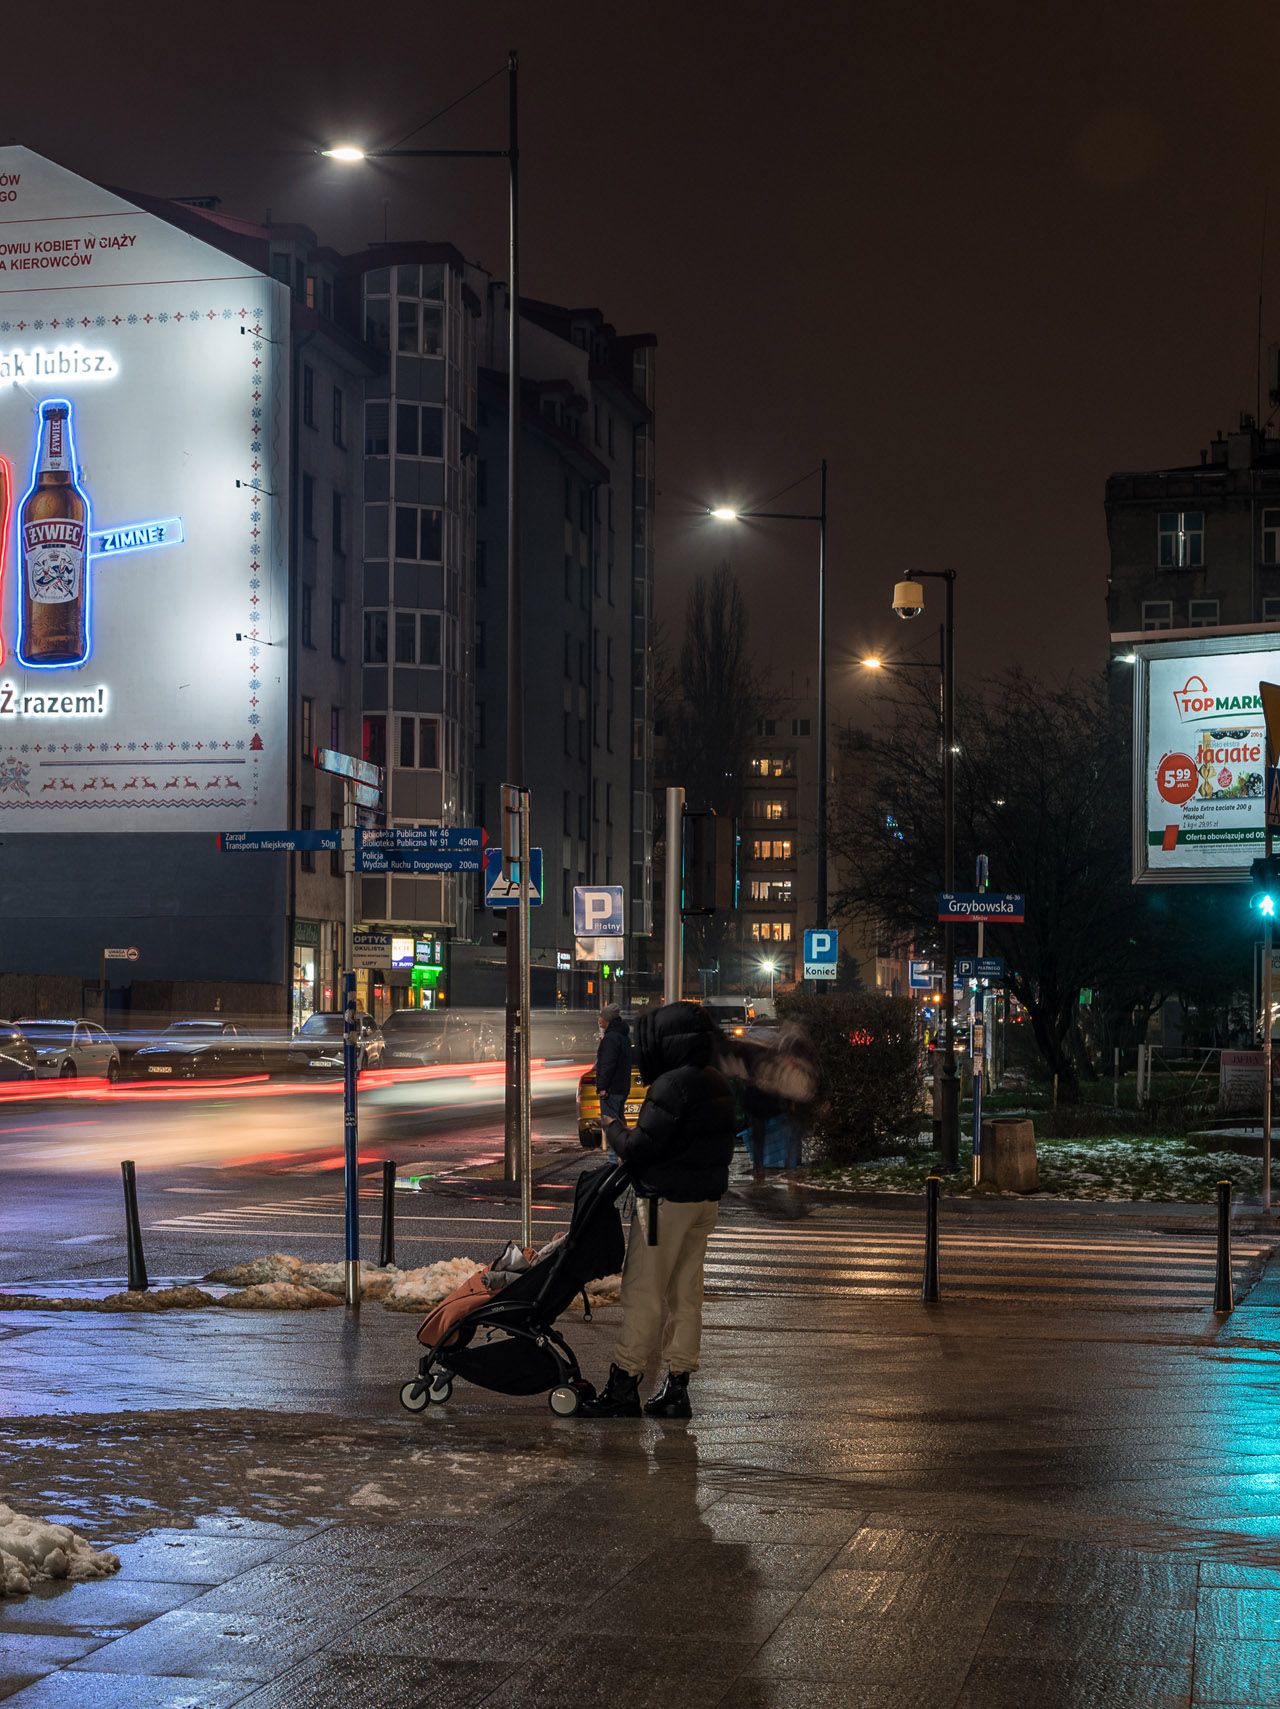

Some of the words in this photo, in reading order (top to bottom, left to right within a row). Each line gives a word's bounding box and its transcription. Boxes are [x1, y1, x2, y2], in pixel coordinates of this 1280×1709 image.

[34, 239, 81, 253] KOBIET
[84, 238, 96, 249] W
[99, 233, 137, 250] CIĄŻY
[10, 253, 93, 271] KIEROWCÓW
[35, 350, 113, 375] lubisz.
[50, 418, 62, 453] ŻYWIEC
[28, 523, 81, 545] ŻYWIEC
[103, 526, 167, 551] ZIMNE?
[0, 683, 14, 714] Ż
[23, 688, 104, 714] razem!
[1182, 813, 1205, 821] Mlekpol
[225, 832, 246, 841] Zarząd
[362, 830, 394, 839] Biblioteka
[396, 829, 427, 838] Publiczna
[429, 829, 438, 837] Nr
[440, 829, 450, 837] 46
[1185, 833, 1207, 841] Oferta
[1207, 832, 1245, 841] obowiązuje
[1245, 831, 1255, 839] od
[225, 841, 259, 851] Transportu
[260, 840, 296, 851] Miejskiego
[321, 839, 336, 849] 50m
[362, 839, 395, 847] Biblioteka
[396, 838, 428, 847] Publiczna
[429, 838, 438, 846] Nr
[440, 838, 448, 846] 91
[458, 838, 479, 846] 450m
[362, 851, 384, 861] Policja
[362, 860, 389, 870] Wydział
[391, 861, 411, 869] Ruchu
[413, 860, 453, 870] Drogowego
[459, 860, 479, 869] 200m
[948, 899, 1014, 915] Grzybowska
[354, 935, 387, 943] OPTYK
[805, 966, 836, 976] Koniec
